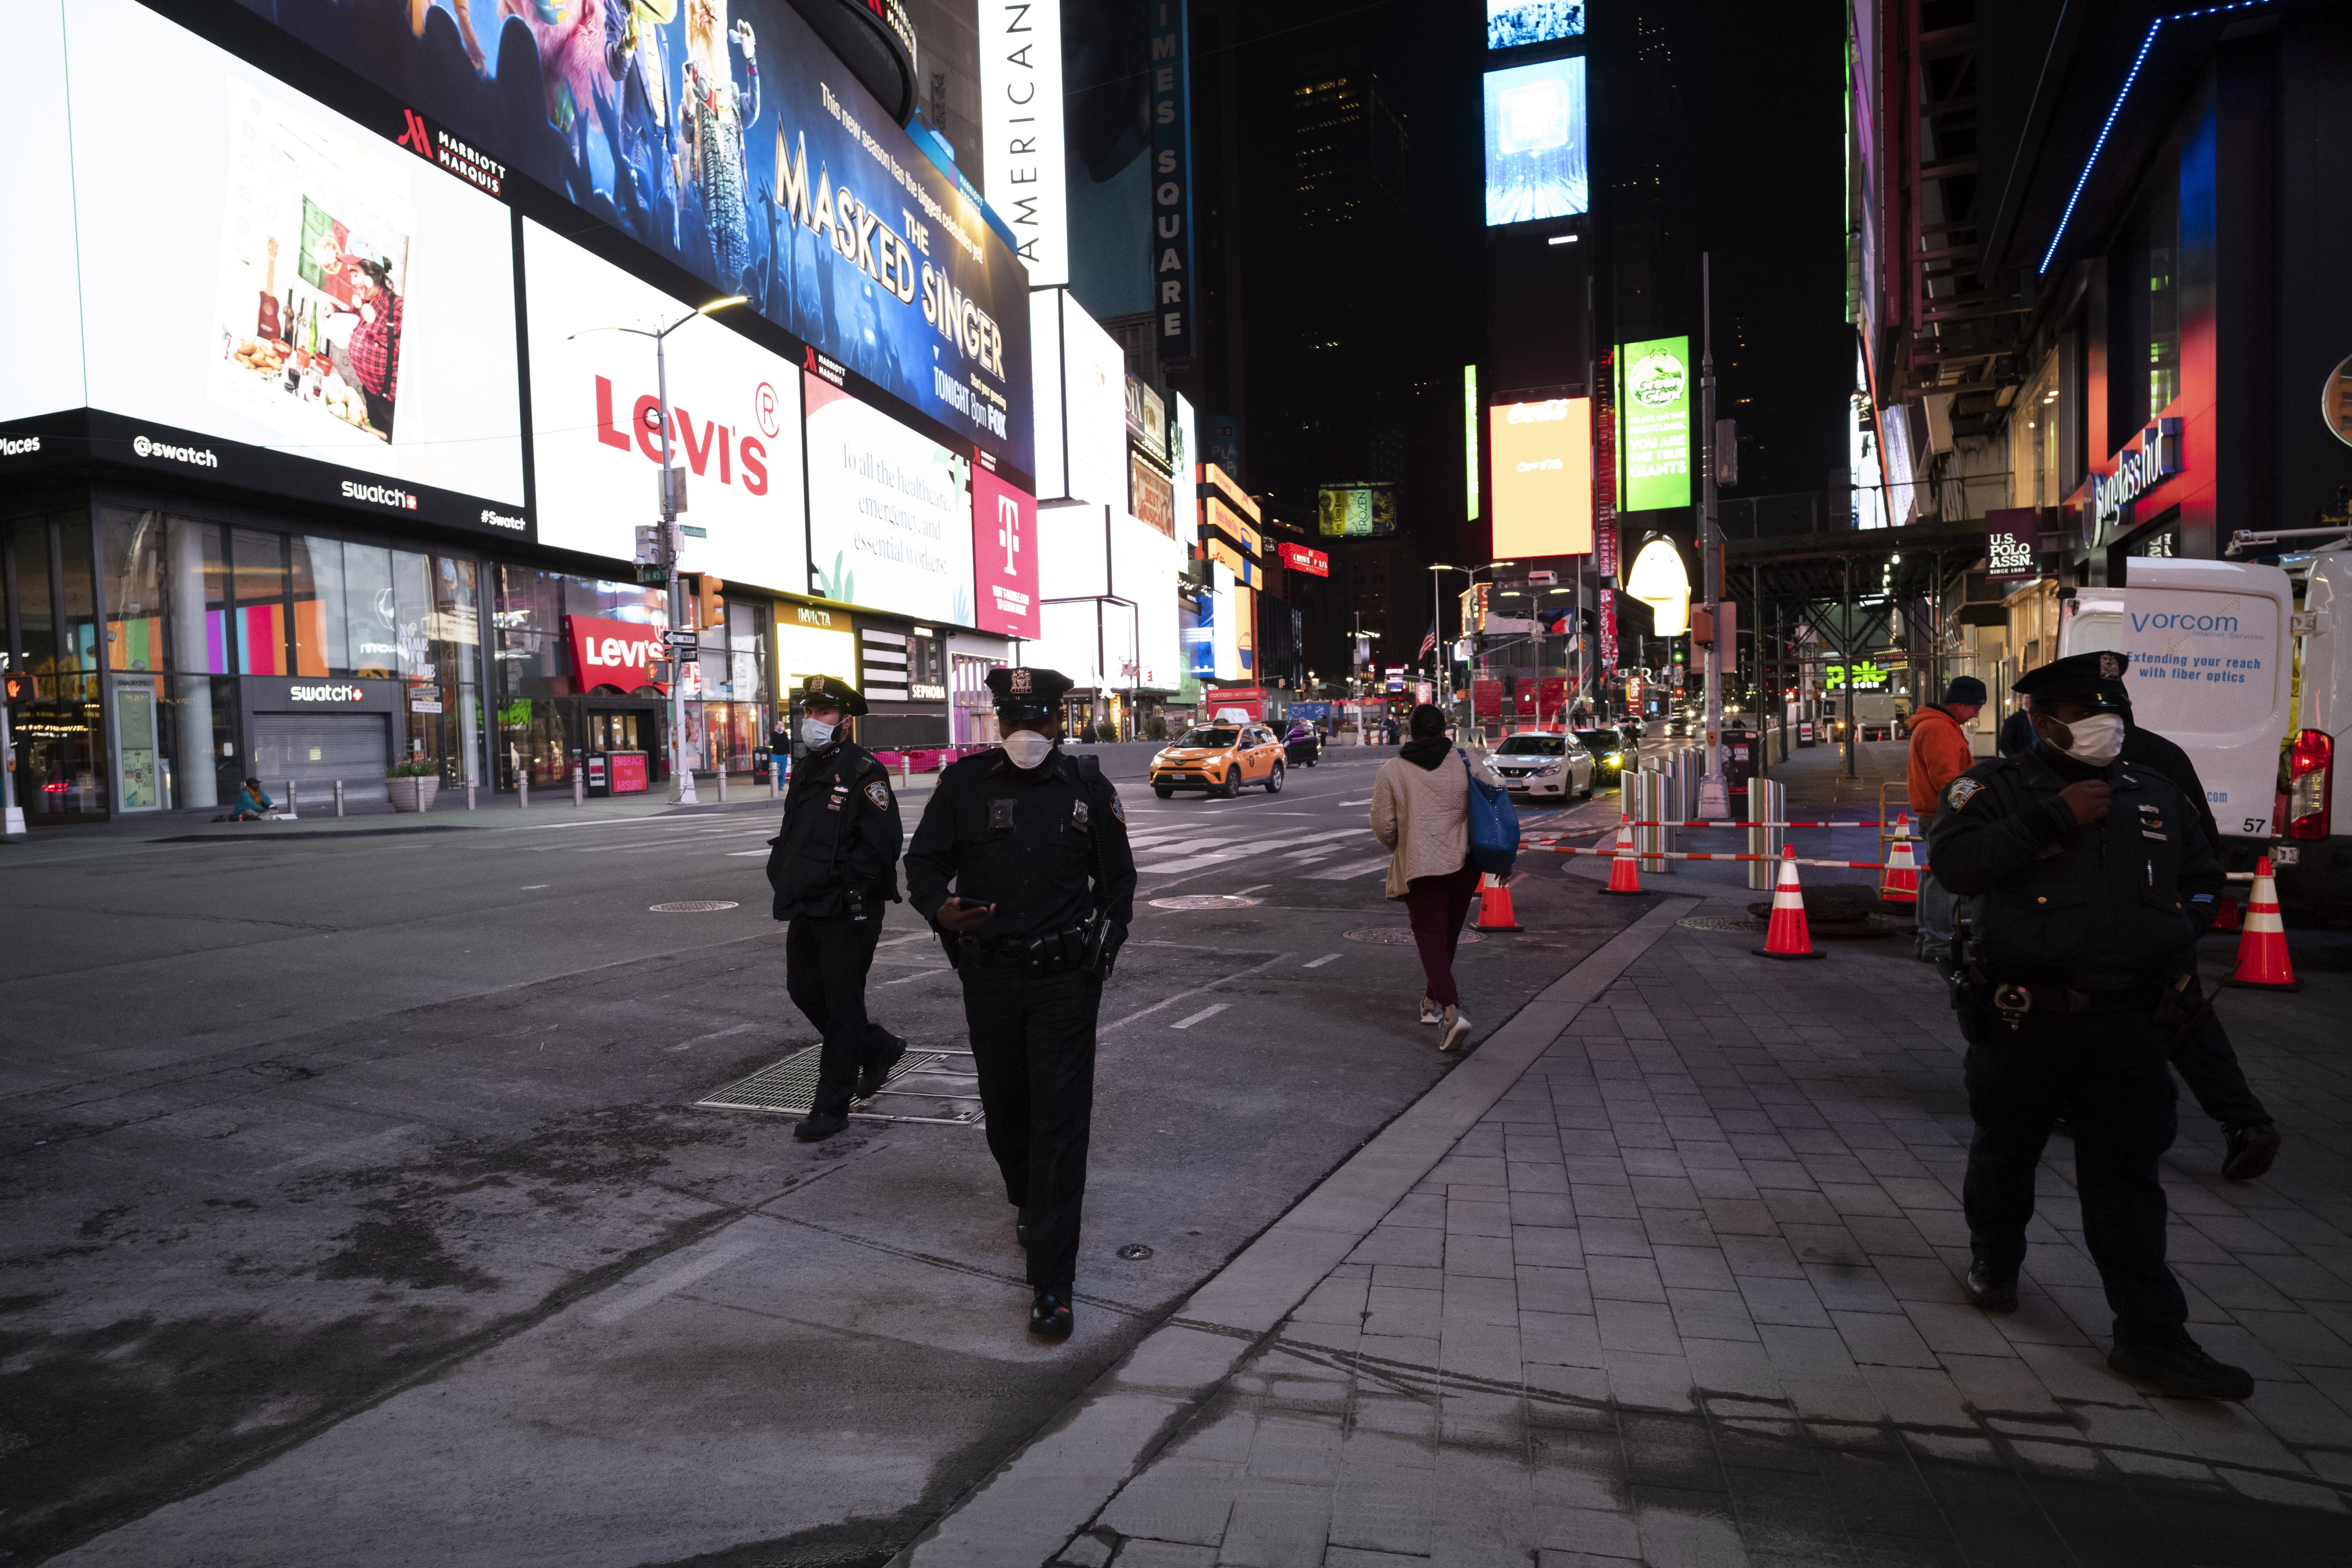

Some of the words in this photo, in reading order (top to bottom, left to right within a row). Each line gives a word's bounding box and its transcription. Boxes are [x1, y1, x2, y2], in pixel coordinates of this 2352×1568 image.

[1005, 3, 1039, 263] AMERICAN
[439, 130, 505, 180] MARRIOTT
[821, 81, 841, 120] This
[842, 109, 861, 140] new
[862, 130, 891, 171] season
[891, 155, 905, 185] has
[905, 171, 917, 198] the
[918, 183, 942, 224] biggest
[439, 149, 499, 193] MARQUIS
[960, 174, 983, 207] MARRIOTT
[902, 207, 929, 256] THE
[774, 111, 915, 305] MASKED
[921, 261, 1006, 383] SINGER
[1156, 149, 1181, 337] SQUARE
[818, 355, 845, 376] MARRIOTT
[819, 366, 843, 386] MARQUIS
[971, 373, 982, 390] Start
[981, 382, 990, 399] your
[1636, 377, 1682, 394] Green
[934, 366, 969, 416] TONIGHT
[971, 392, 987, 427] 8pm
[987, 403, 1007, 440] FOX
[1124, 374, 1143, 423] SIX
[1641, 387, 1683, 403] Giant
[1629, 438, 1657, 451] YOU
[1660, 434, 1686, 447] ARE
[134, 436, 217, 468] @swatch
[980, 450, 997, 464] MARRIOTT
[1629, 451, 1653, 463] THE
[1655, 448, 1686, 460] TRUE
[840, 441, 856, 472] To
[860, 453, 873, 479] all
[877, 459, 895, 488] the
[1629, 460, 1687, 478] GIANTS
[342, 481, 405, 508] swatch
[1145, 486, 1159, 510] BEST
[1356, 492, 1369, 532] FROZEN
[681, 526, 705, 538] Broadway
[923, 520, 941, 541] and
[1990, 533, 2016, 545] U.S.
[854, 533, 903, 563] essential
[1990, 543, 2030, 556] POLO
[1990, 554, 2034, 568] ASSN.
[645, 572, 650, 580] W
[653, 571, 660, 579] 45
[997, 598, 1003, 610] TO
[798, 608, 831, 626] INVICTA
[2131, 612, 2238, 632] Vorcom
[399, 623, 415, 637] NO
[399, 636, 429, 651] TIME
[409, 651, 424, 664] TO
[2126, 651, 2187, 666] Extending
[2193, 656, 2221, 667] your
[2226, 658, 2261, 669] reach
[417, 664, 436, 677] DIE
[2139, 667, 2166, 678] with
[2172, 668, 2201, 680] fiber
[2206, 671, 2245, 683] optics
[290, 685, 351, 701] swatch
[912, 684, 945, 699] SEPHORA
[1419, 684, 1429, 703] tkts
[1629, 677, 1640, 697] tkts
[614, 755, 643, 767] EMBRACE
[617, 779, 643, 791] ABSURD
[2243, 818, 2266, 833] 57
